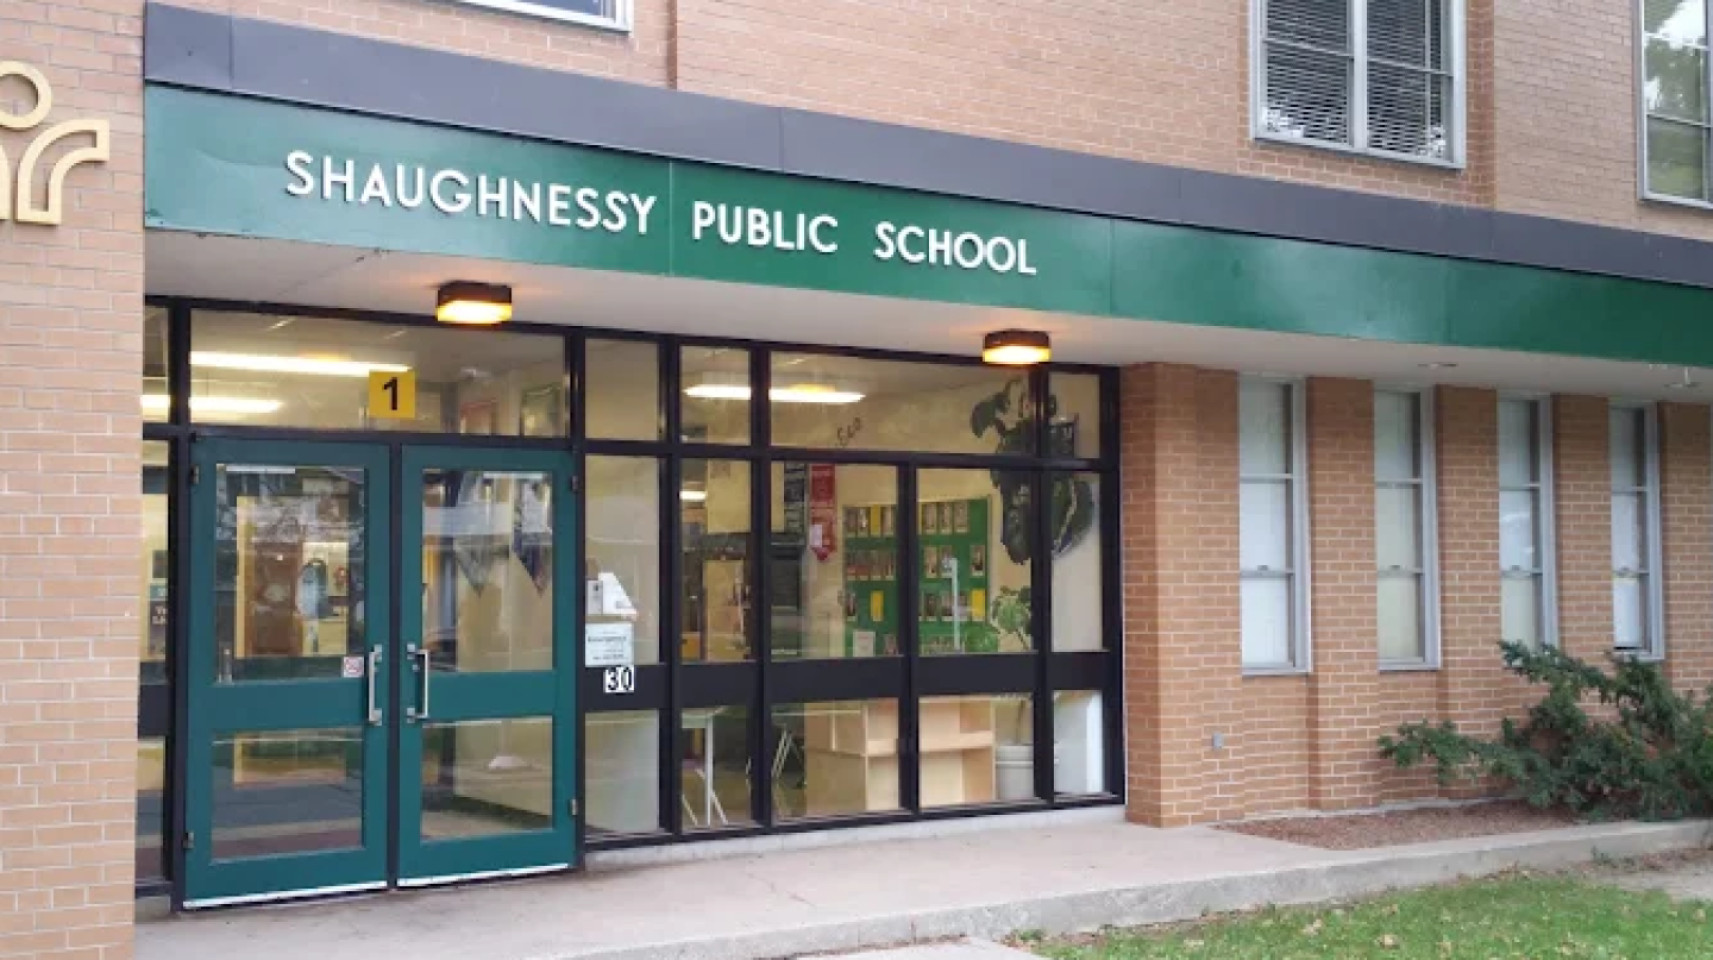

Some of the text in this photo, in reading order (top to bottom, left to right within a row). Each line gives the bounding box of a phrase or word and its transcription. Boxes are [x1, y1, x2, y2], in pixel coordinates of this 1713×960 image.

[285, 150, 1037, 276] SHAUGHNESSY PUBLIC SCHOOL
[383, 376, 398, 411] 1
[607, 666, 633, 691] 30
